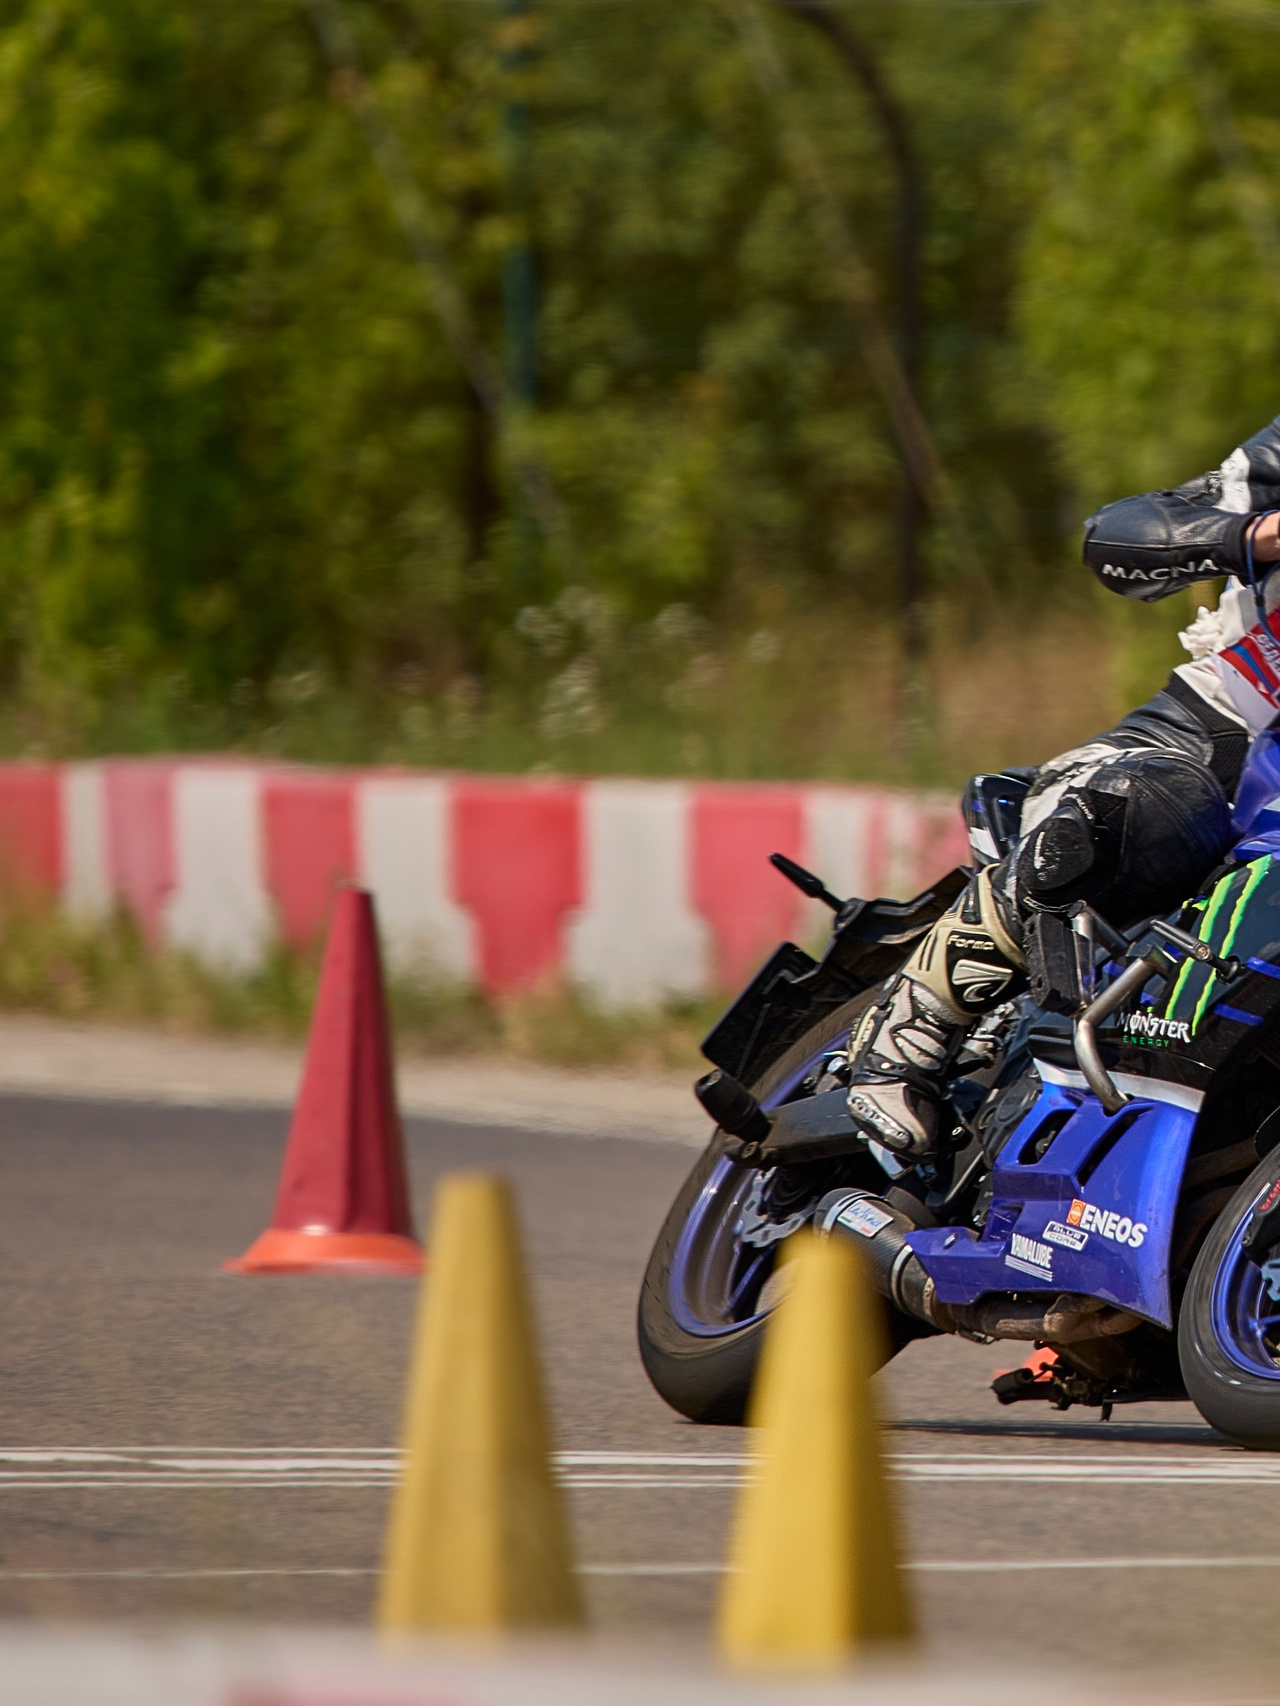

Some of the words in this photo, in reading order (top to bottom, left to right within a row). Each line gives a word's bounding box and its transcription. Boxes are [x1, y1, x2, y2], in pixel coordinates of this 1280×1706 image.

[1116, 1010, 1191, 1043] MONSTER
[1122, 1035, 1170, 1048] ENERGY
[1079, 1204, 1148, 1248] ENEOS
[1011, 1233, 1053, 1269] YAMALUBE
